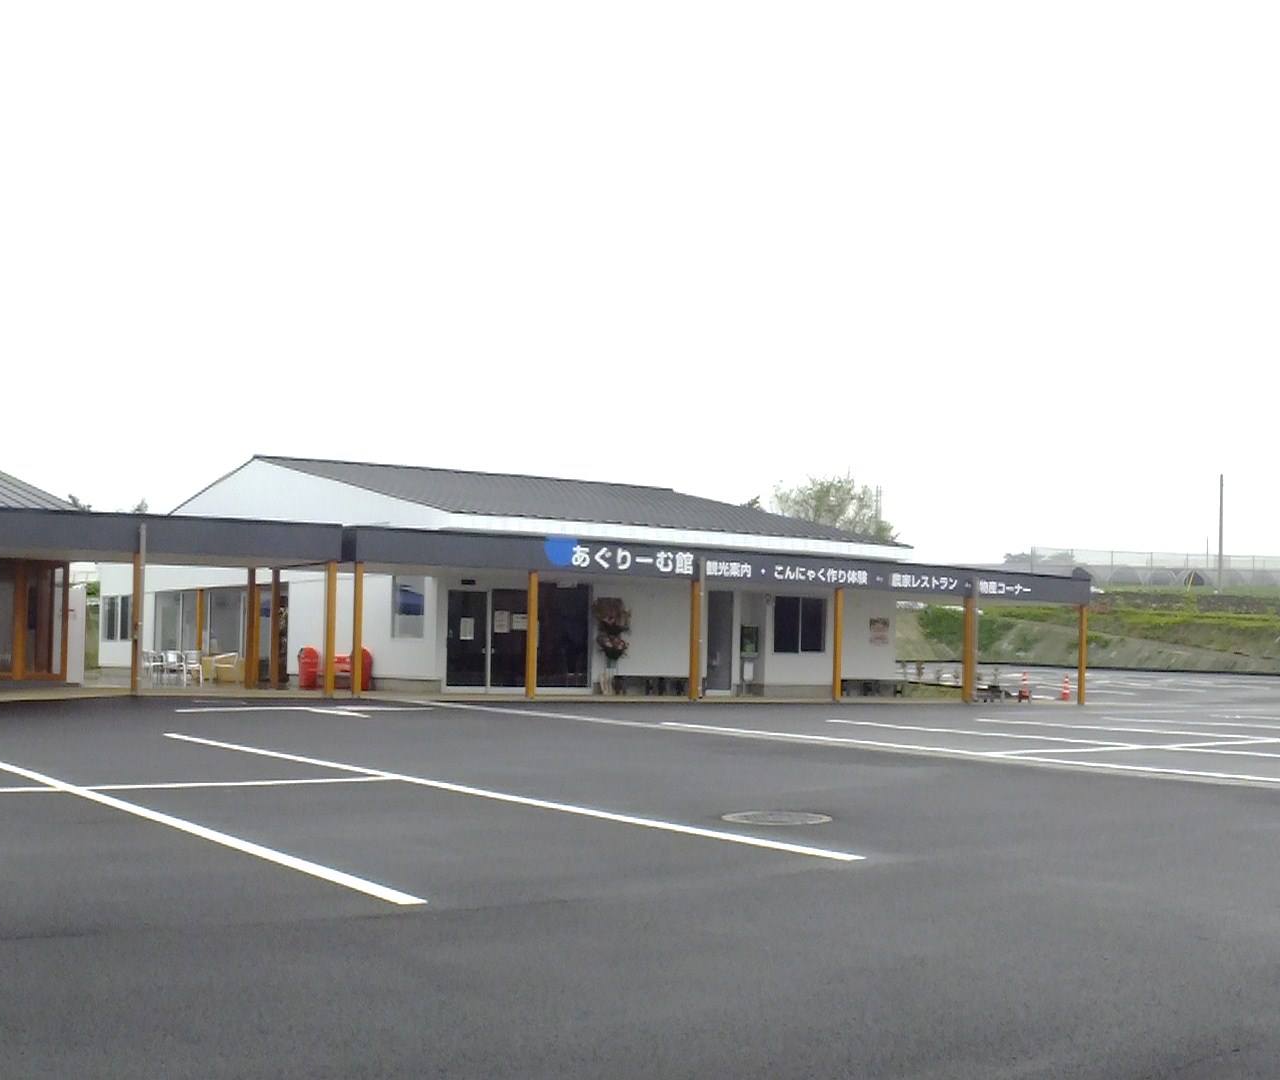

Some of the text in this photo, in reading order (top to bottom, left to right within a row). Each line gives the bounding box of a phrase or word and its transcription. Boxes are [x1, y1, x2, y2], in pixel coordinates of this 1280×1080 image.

[571, 544, 695, 576] あぐりーむ館
[705, 560, 752, 579] 観光案内
